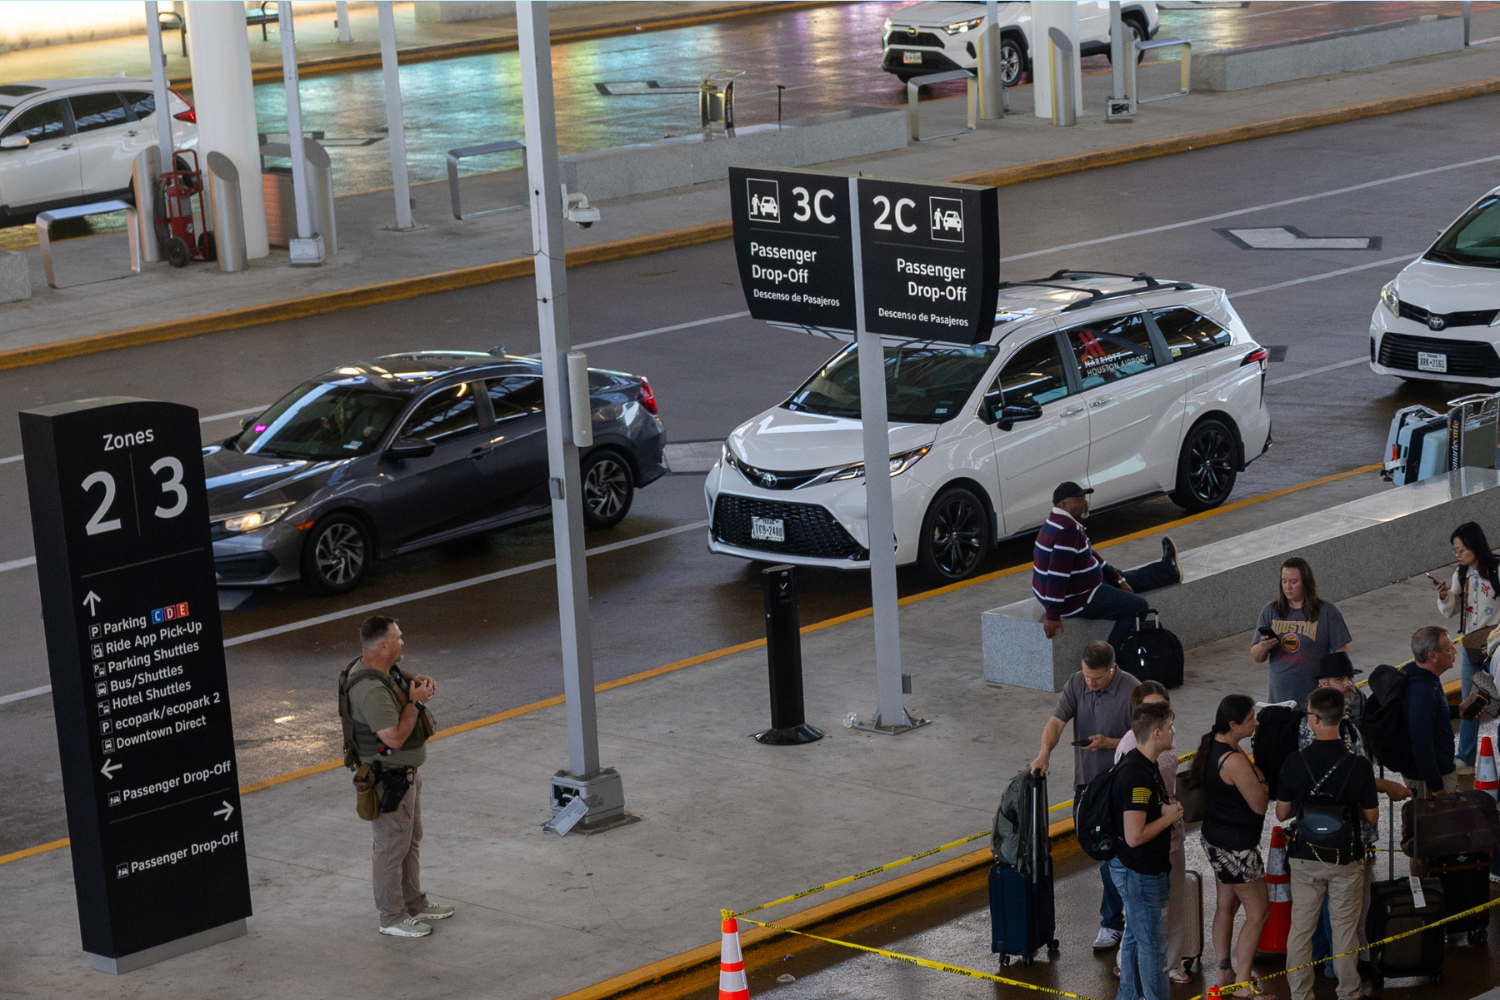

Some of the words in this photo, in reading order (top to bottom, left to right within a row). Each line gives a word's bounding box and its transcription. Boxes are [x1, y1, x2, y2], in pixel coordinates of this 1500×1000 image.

[791, 185, 837, 225] 3C
[872, 194, 918, 234] 2C
[750, 242, 817, 266] Passenger
[751, 264, 809, 285] Drop-Off
[896, 257, 966, 283] Passenger
[753, 288, 790, 303] Descenso
[791, 291, 802, 303] de
[803, 293, 841, 308] Pasajeros
[908, 281, 967, 302] Drop-Off
[878, 307, 917, 321] Descenso
[918, 310, 929, 322] de
[930, 312, 969, 328] Pasajeros
[1084, 351, 1122, 368] MARRIOTT
[1086, 362, 1120, 377] HOUSTON
[1120, 353, 1149, 368] AIRPORT
[102, 428, 155, 452] Zones
[80, 470, 122, 537] 2
[149, 456, 188, 519] 3
[103, 615, 147, 635] Parking
[106, 638, 131, 654] Ride
[134, 633, 157, 648] App
[159, 620, 203, 641] Pick-Up
[108, 654, 151, 673] Parking
[153, 641, 200, 662] Shuttles
[110, 664, 184, 692] Bus/Shuttles
[112, 690, 143, 710] Hotel
[145, 680, 192, 701] Shuttles
[115, 694, 211, 730] ecopark/ecopark
[213, 692, 220, 705] 2
[116, 726, 173, 749] Downtown
[175, 714, 207, 733] Direct
[123, 776, 180, 802] Passenger
[183, 760, 231, 784] Drop-Off
[131, 847, 188, 873] Passenger
[191, 830, 239, 855] Drop-Off
